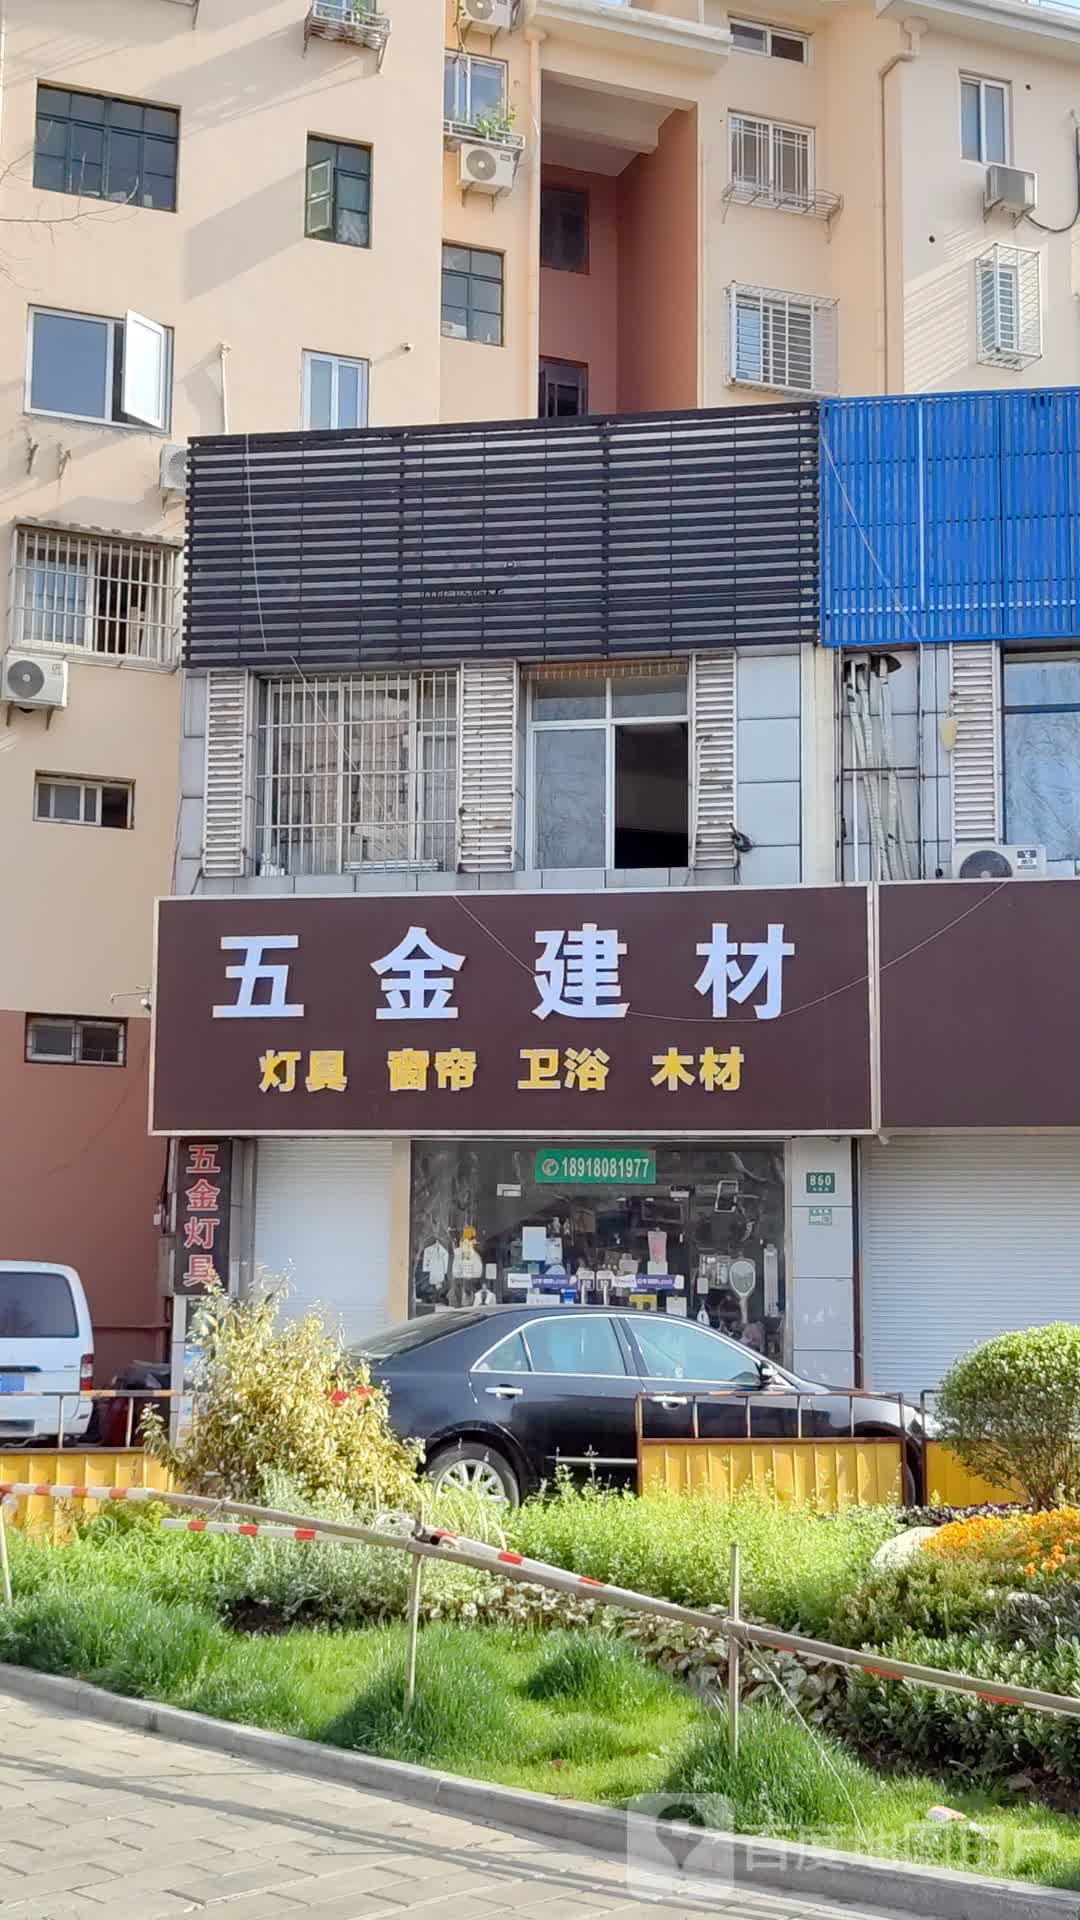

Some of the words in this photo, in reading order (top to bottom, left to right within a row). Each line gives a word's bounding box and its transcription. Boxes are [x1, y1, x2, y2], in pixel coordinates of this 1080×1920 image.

[211, 922, 796, 1020] 五金建材
[258, 1049, 348, 1093] 灯具
[386, 1047, 478, 1092] 窗帘
[517, 1047, 610, 1092] 卫浴
[650, 1046, 745, 1092] 木材
[561, 1157, 650, 1178] 18918081977
[809, 1174, 832, 1186] 860
[183, 1144, 221, 1288] 五金灯具
